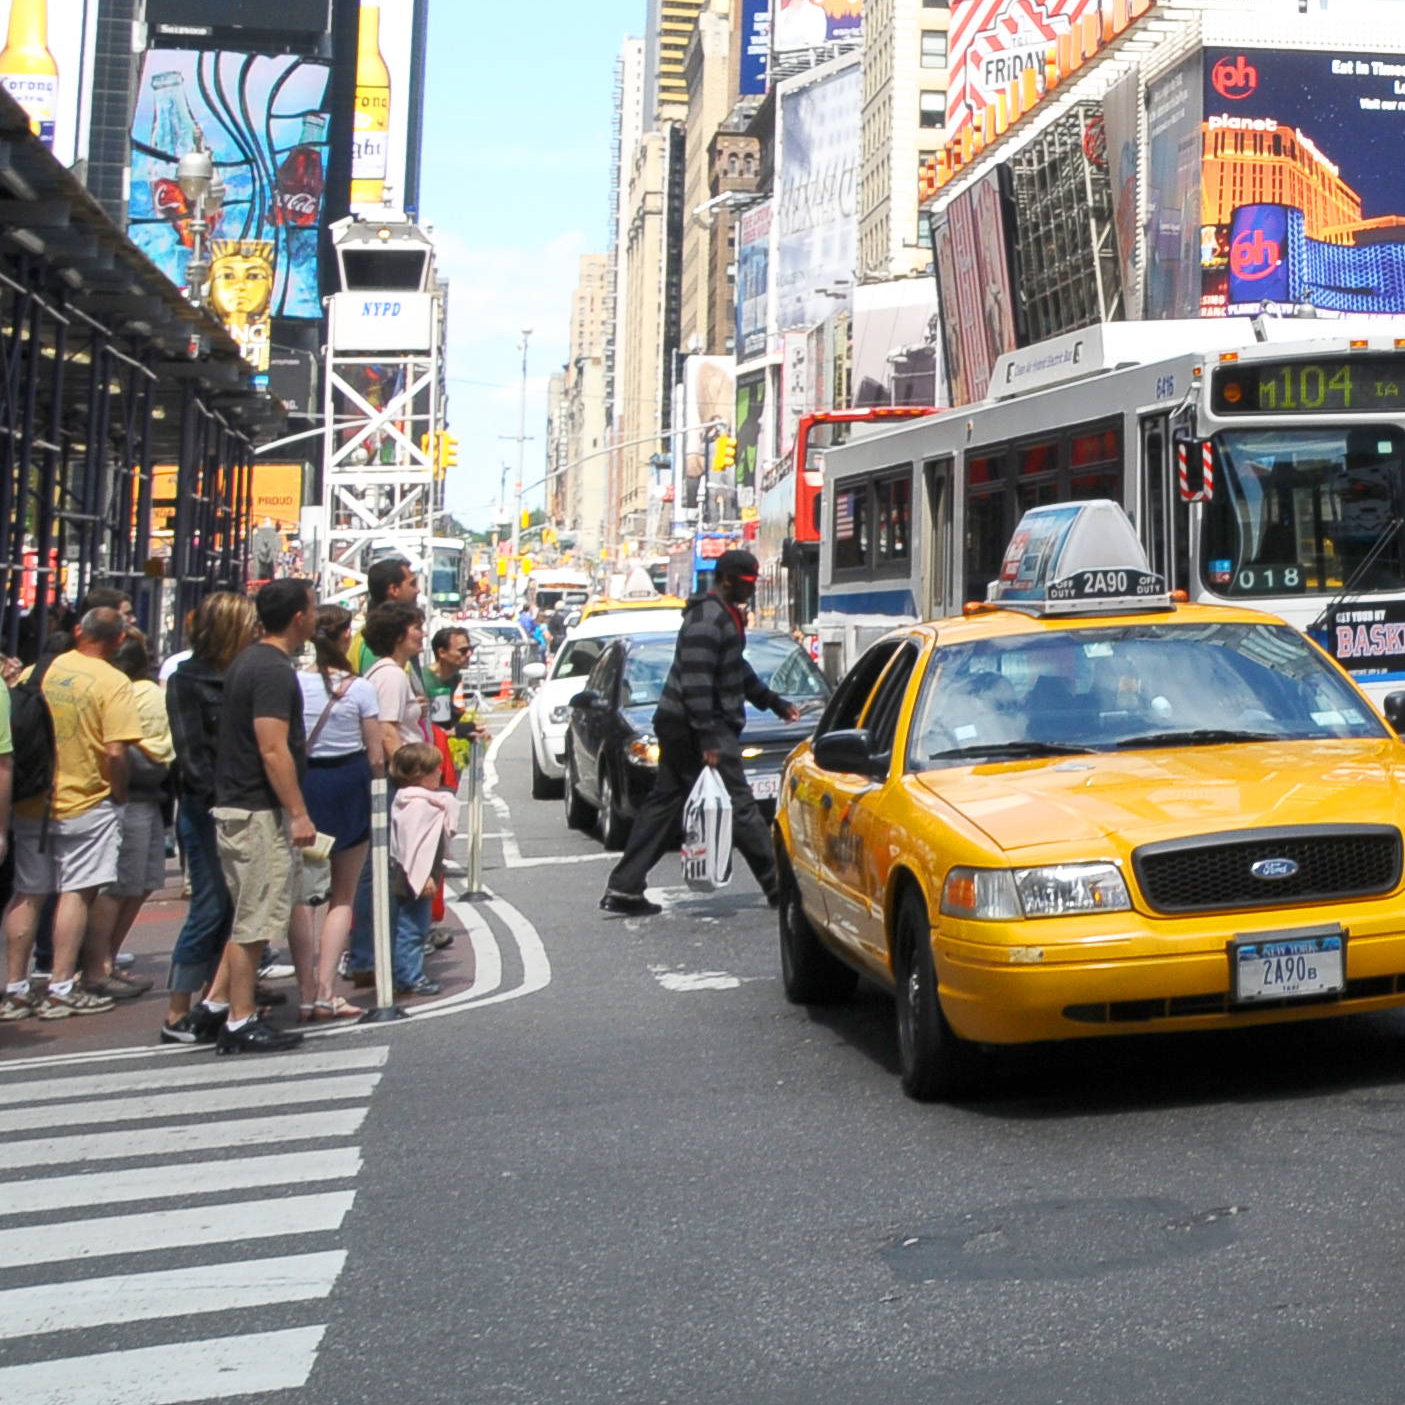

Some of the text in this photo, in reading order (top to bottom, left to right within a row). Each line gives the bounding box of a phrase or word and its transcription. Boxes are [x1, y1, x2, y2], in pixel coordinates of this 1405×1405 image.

[1332, 59, 1354, 74] Eat
[1209, 113, 1278, 132] planet
[361, 302, 402, 317] NYPD
[1156, 375, 1175, 399] 6416
[258, 496, 293, 506] PROUD
[1055, 571, 1157, 594] OFF 2A90 OFF
[1051, 584, 1161, 599] DUTY DUTY
[1262, 862, 1288, 875] Ford
